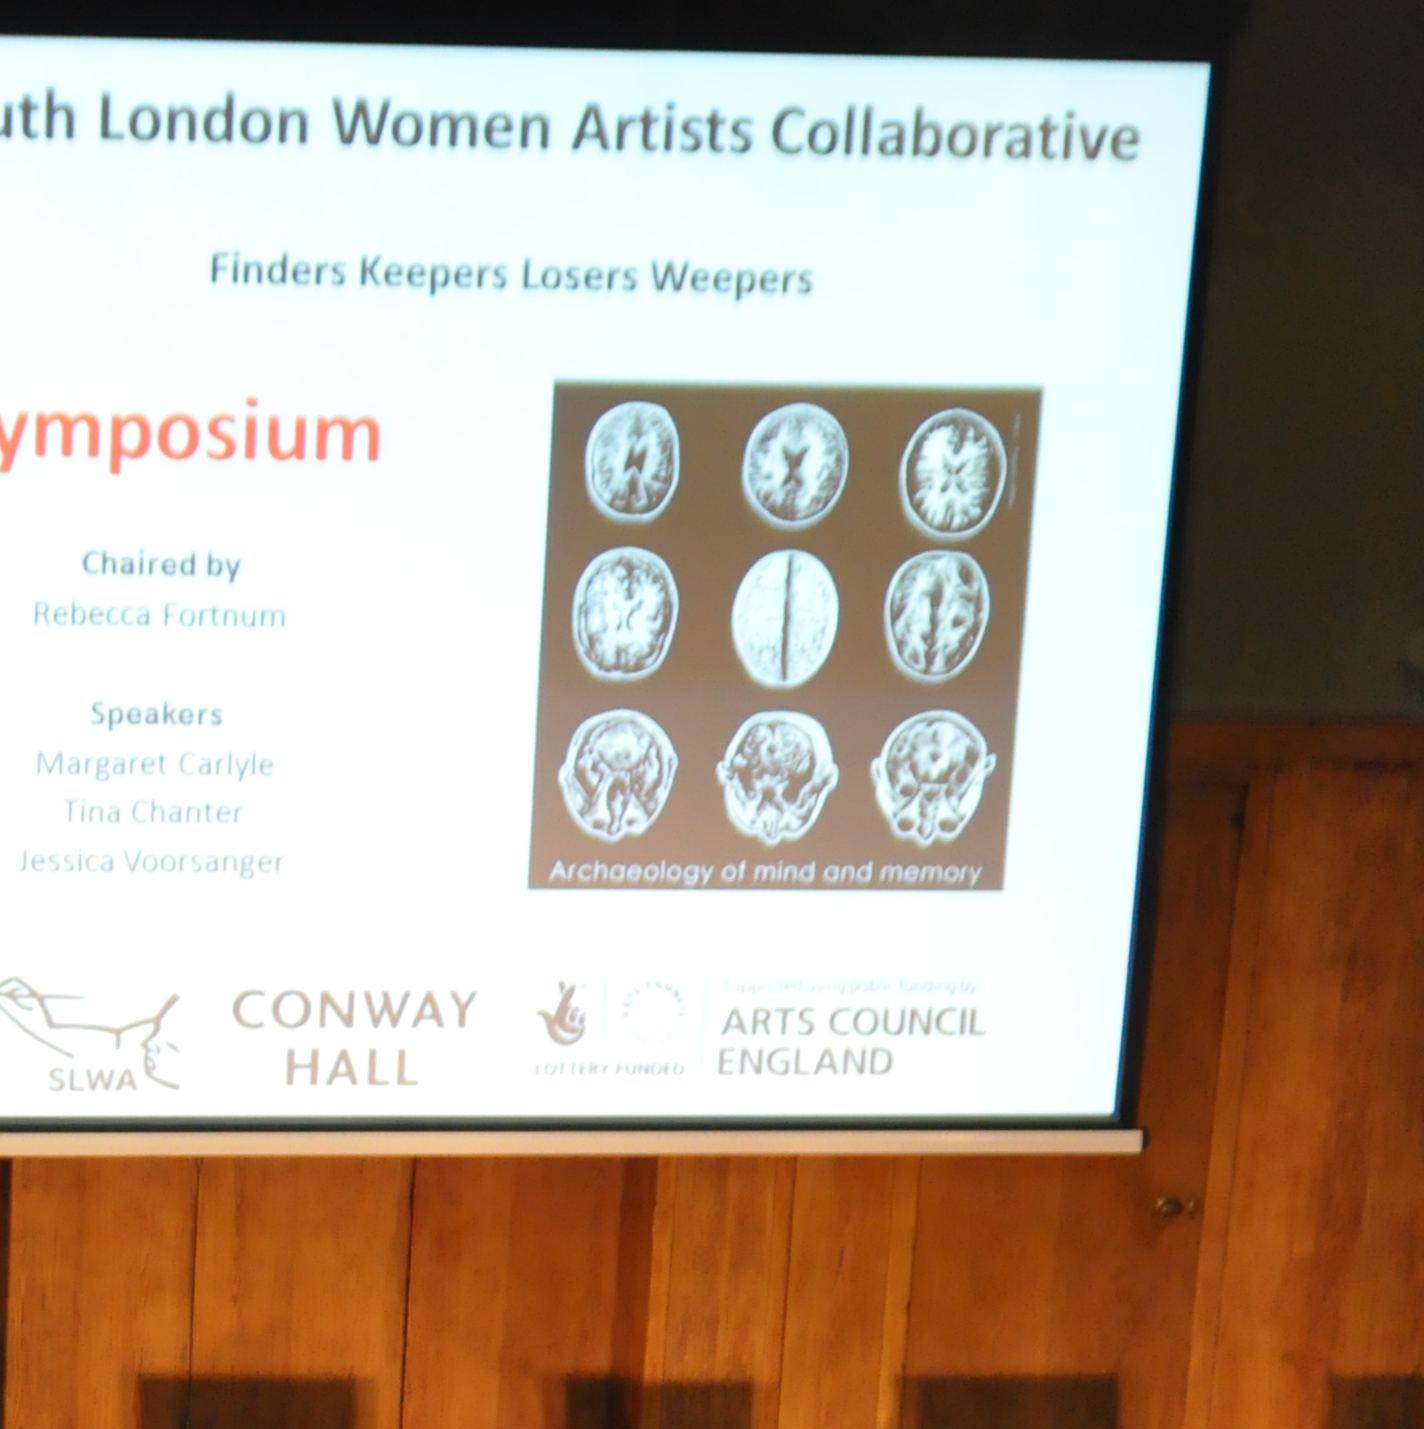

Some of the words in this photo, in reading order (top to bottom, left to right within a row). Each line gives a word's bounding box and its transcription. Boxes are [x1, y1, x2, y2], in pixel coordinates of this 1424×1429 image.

[100, 91, 309, 145] London
[332, 97, 550, 151] Women
[570, 101, 753, 155] Artists
[771, 104, 1141, 162] Collaborative
[210, 251, 346, 287] Finders
[359, 255, 508, 297] Keepers
[522, 258, 638, 293] Losers
[651, 260, 813, 302] Weepers
[81, 549, 197, 577] Chaired
[206, 551, 241, 584] by
[33, 600, 151, 627] Rebecca
[163, 602, 286, 628] Fortnum
[91, 700, 223, 732] Speakers
[36, 751, 166, 782] Margaret
[178, 751, 274, 783] Carlyle
[64, 799, 121, 824] Tina
[131, 798, 243, 824] Chanter
[20, 848, 115, 873] Jessica
[123, 849, 284, 880] Voorsanger
[548, 859, 714, 889] Archaeology
[720, 859, 747, 883] of
[752, 859, 816, 884] mind
[822, 860, 874, 883] and
[879, 864, 983, 889] memory
[231, 989, 478, 1030] CONWAY
[720, 1007, 815, 1037] ARTS
[828, 1007, 985, 1037] COUNCIL
[285, 1048, 419, 1087] HALL
[535, 1062, 609, 1076] LOTTERY
[615, 1062, 685, 1076] FUNDED
[717, 1047, 893, 1076] ENGLAND
[48, 1067, 137, 1092] SLWA
